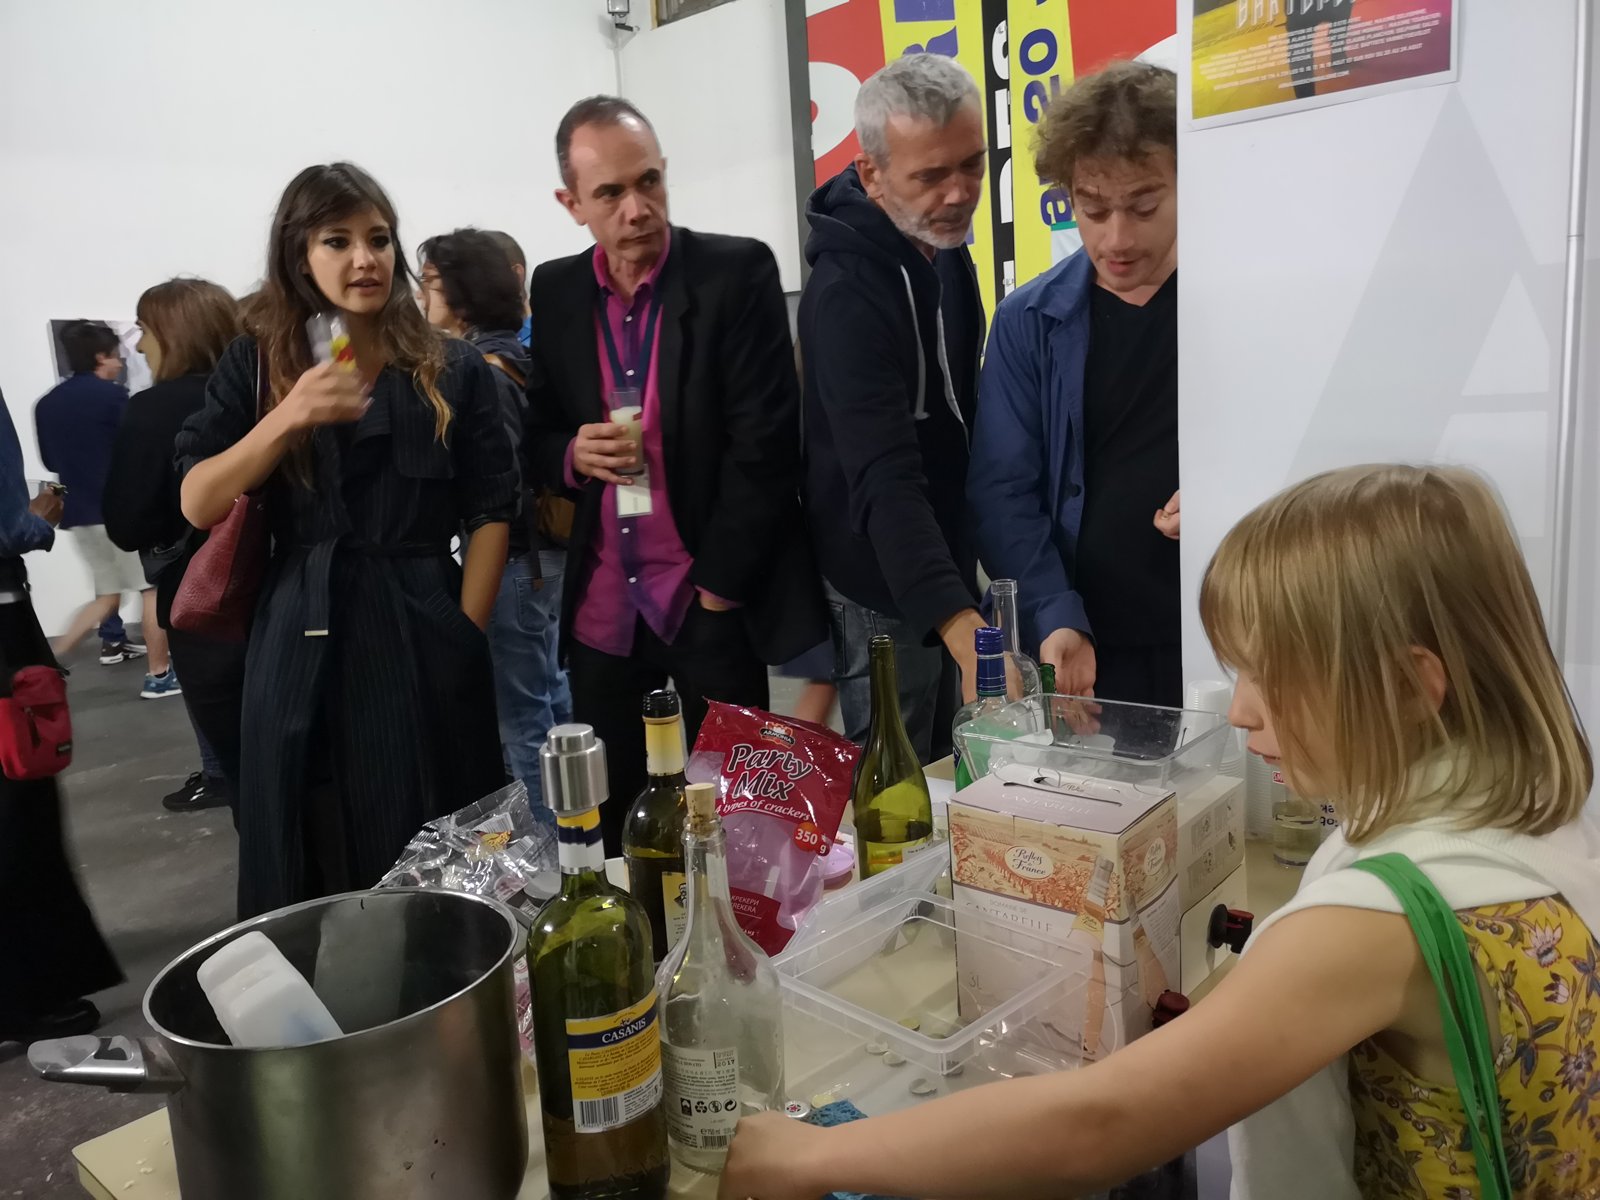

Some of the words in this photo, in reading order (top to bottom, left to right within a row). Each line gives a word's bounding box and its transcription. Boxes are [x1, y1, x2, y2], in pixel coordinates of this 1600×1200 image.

[763, 729, 792, 744] ARMONIA
[726, 743, 814, 780] Party
[731, 769, 795, 801] Mix
[722, 800, 748, 813] types
[749, 799, 766, 810] of
[764, 802, 811, 821] crackers
[795, 828, 818, 845] 350
[820, 844, 827, 854] g
[1011, 857, 1047, 875] France
[731, 902, 758, 915] REKERA
[602, 1017, 647, 1044] CASANIS
